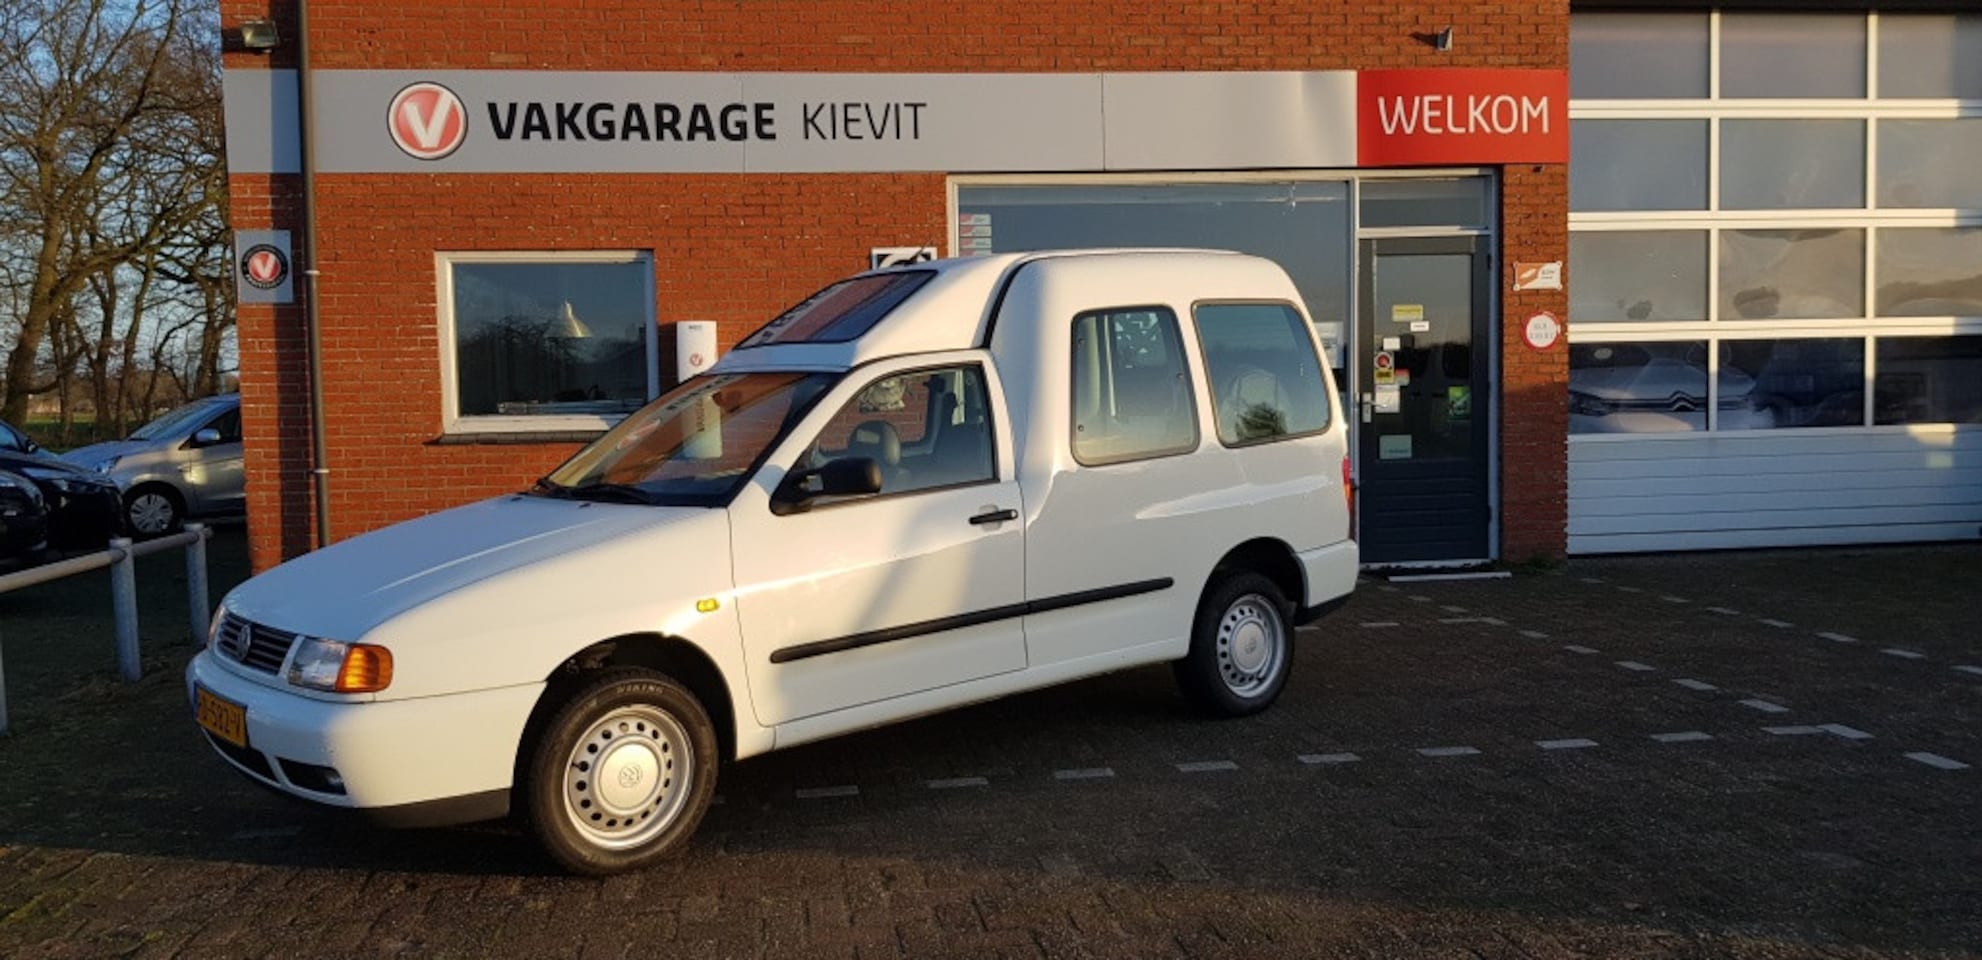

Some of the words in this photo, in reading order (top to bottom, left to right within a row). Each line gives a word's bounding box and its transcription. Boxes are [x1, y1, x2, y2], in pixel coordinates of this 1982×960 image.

[487, 102, 777, 142] VAKGARAGE
[803, 102, 928, 140] KIEVIT
[1377, 94, 1549, 135] WELKOM
